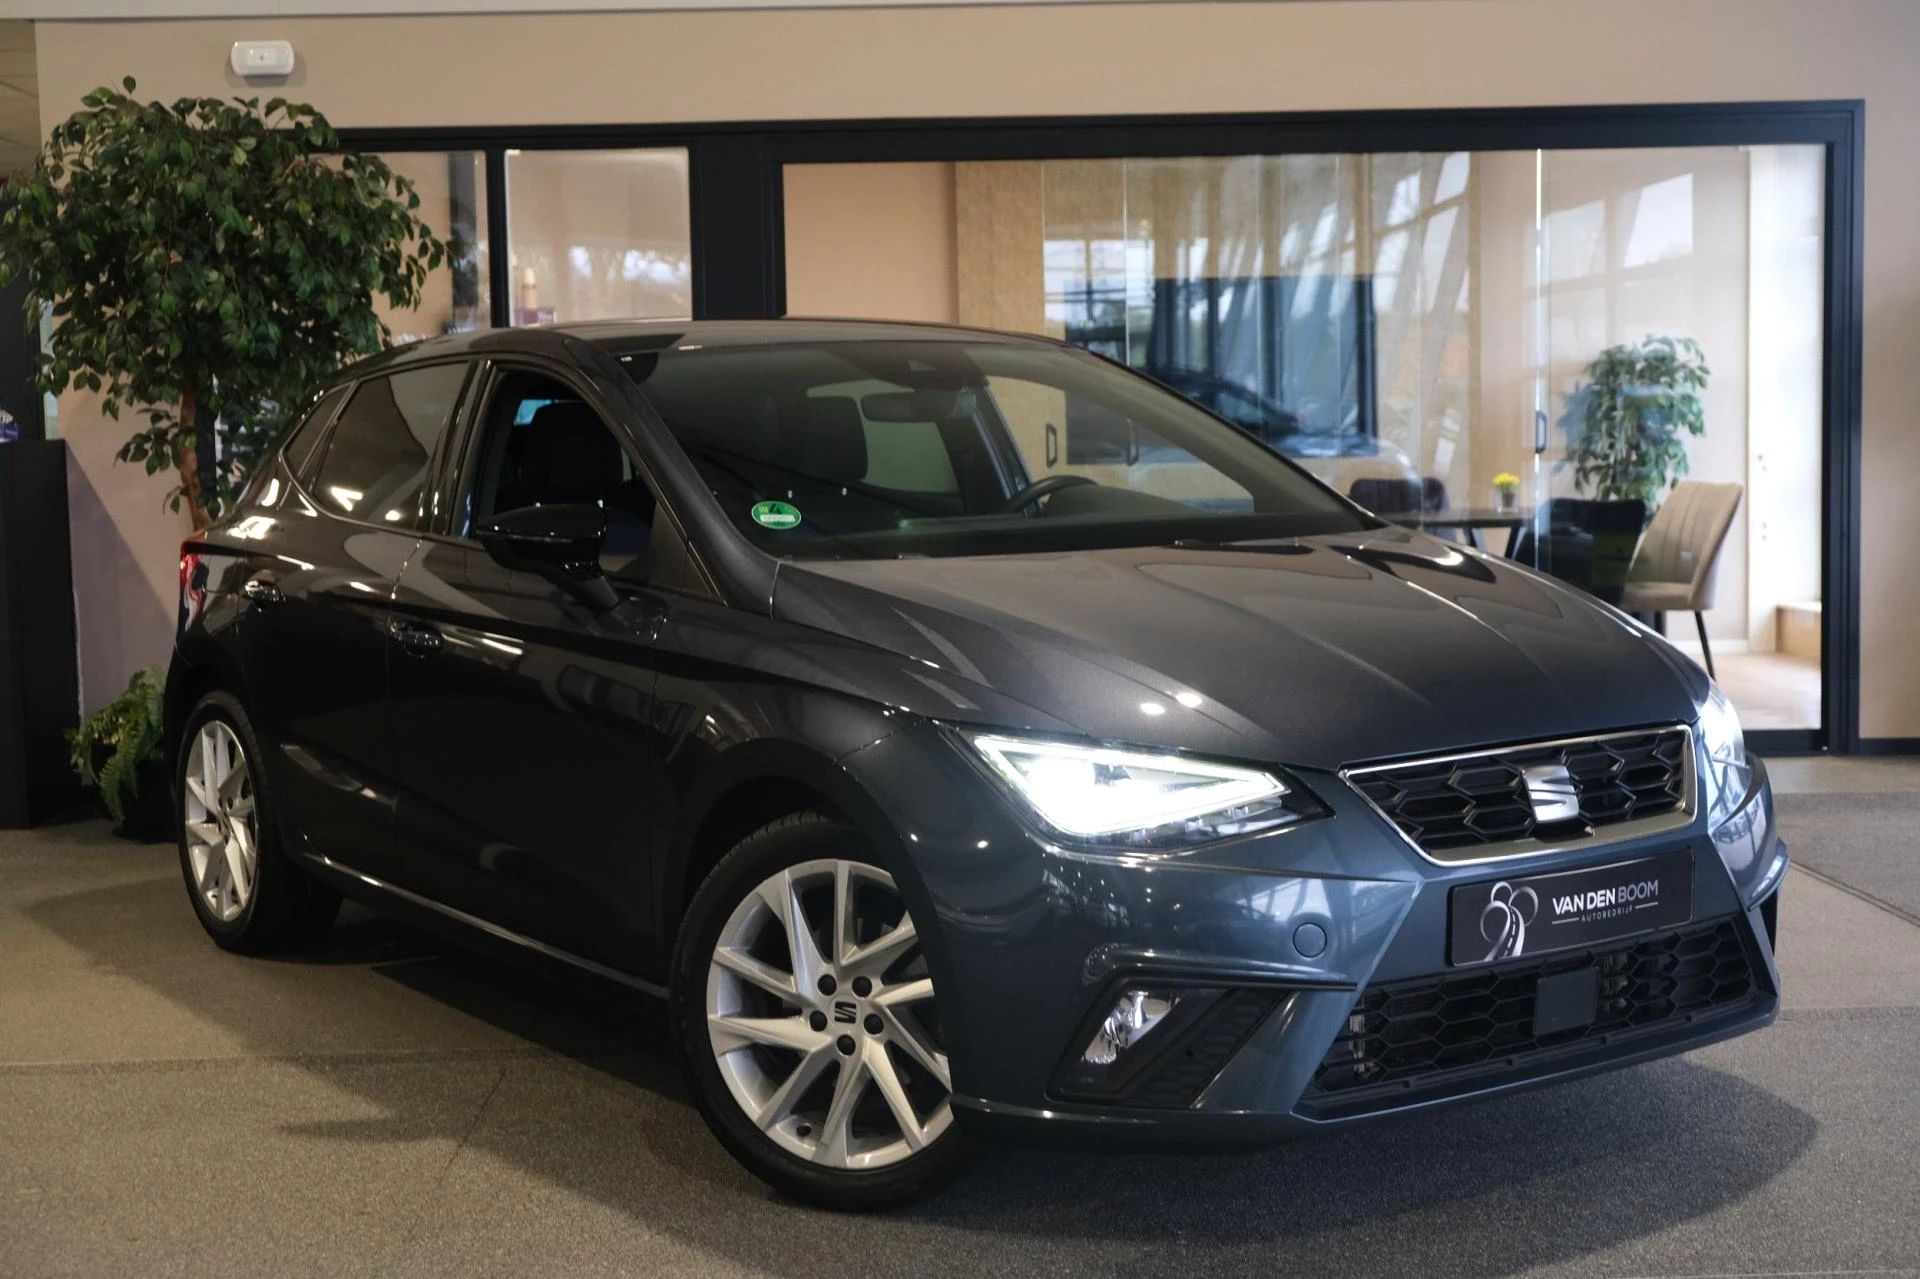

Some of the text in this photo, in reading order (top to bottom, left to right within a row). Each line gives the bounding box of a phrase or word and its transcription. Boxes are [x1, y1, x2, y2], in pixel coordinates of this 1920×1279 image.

[1552, 879, 1659, 915] VAN DEN BOOM
